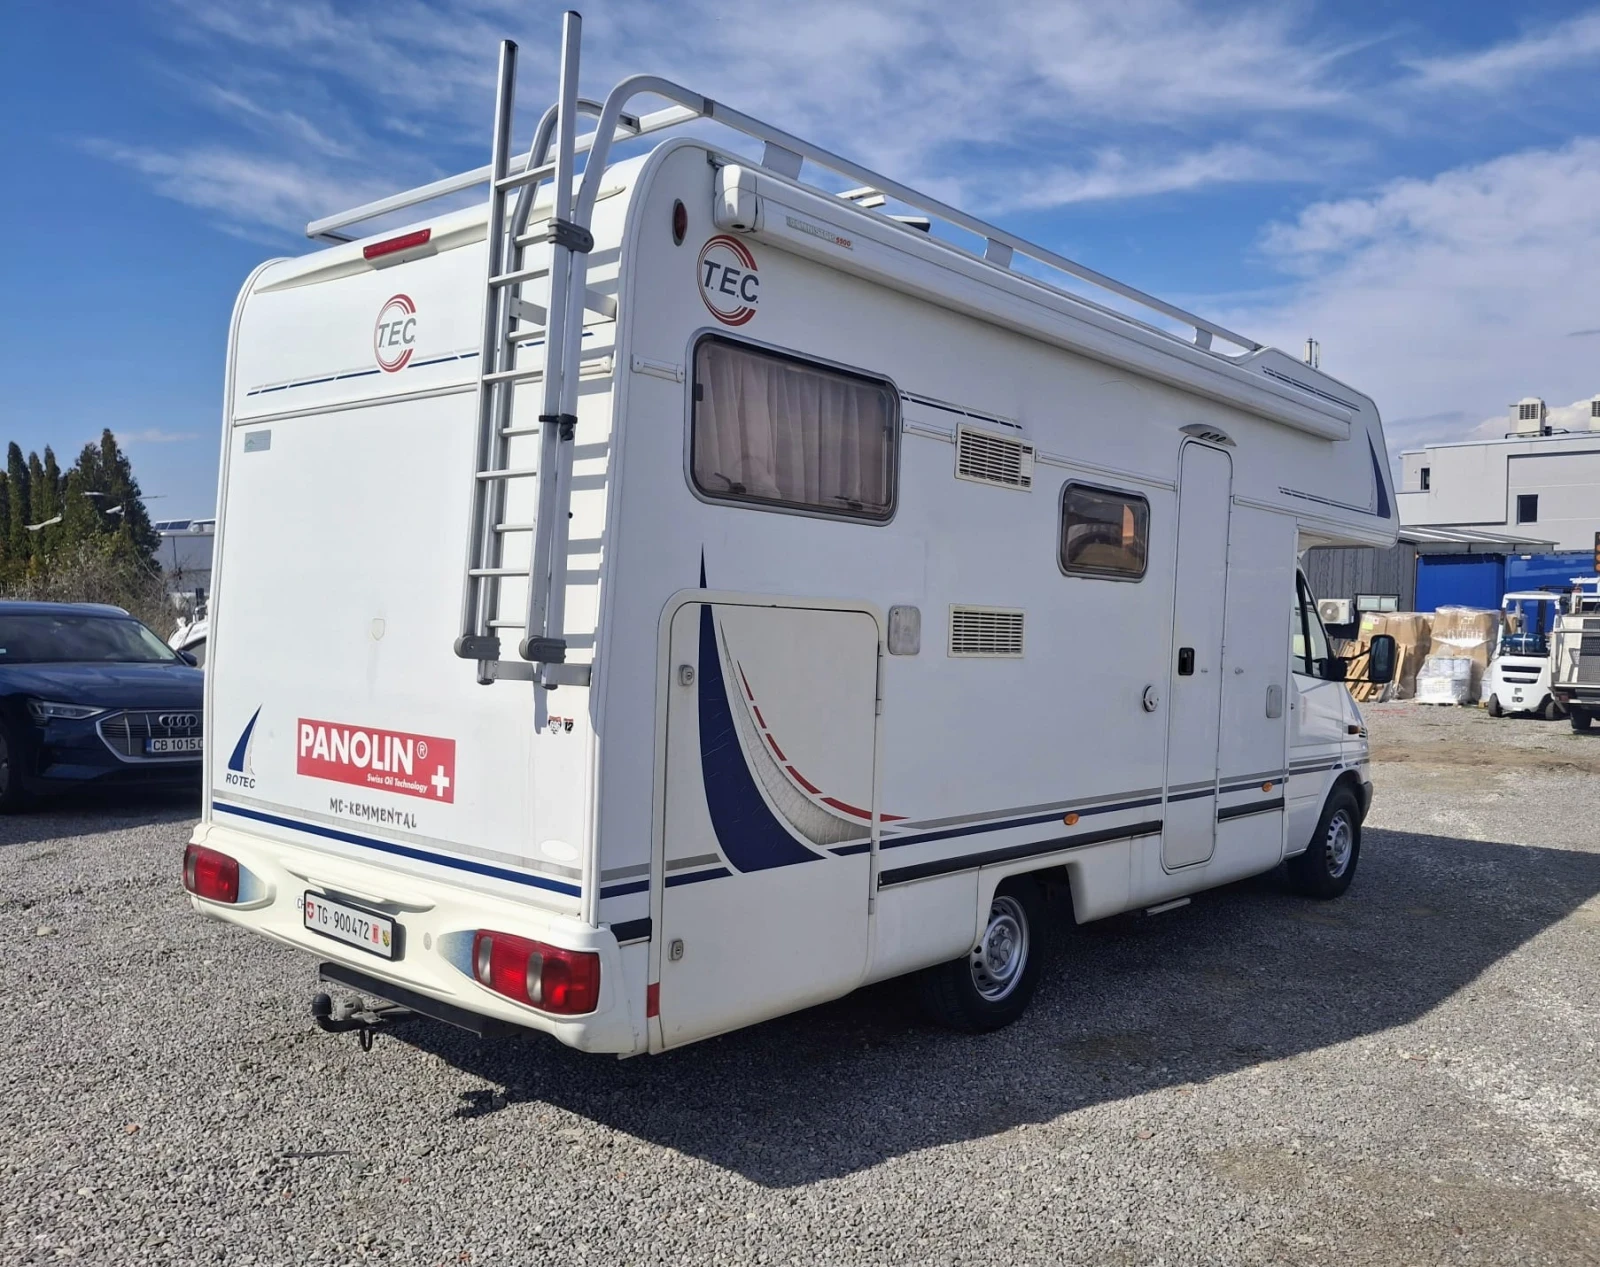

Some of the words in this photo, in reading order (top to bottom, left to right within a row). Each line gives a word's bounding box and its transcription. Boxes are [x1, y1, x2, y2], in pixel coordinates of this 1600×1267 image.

[153, 739, 168, 751] CB
[171, 738, 196, 750] 1015
[225, 773, 256, 789] ROTEC
[367, 773, 384, 786] Swiss
[385, 775, 394, 786] Oil
[394, 777, 428, 794] Technology
